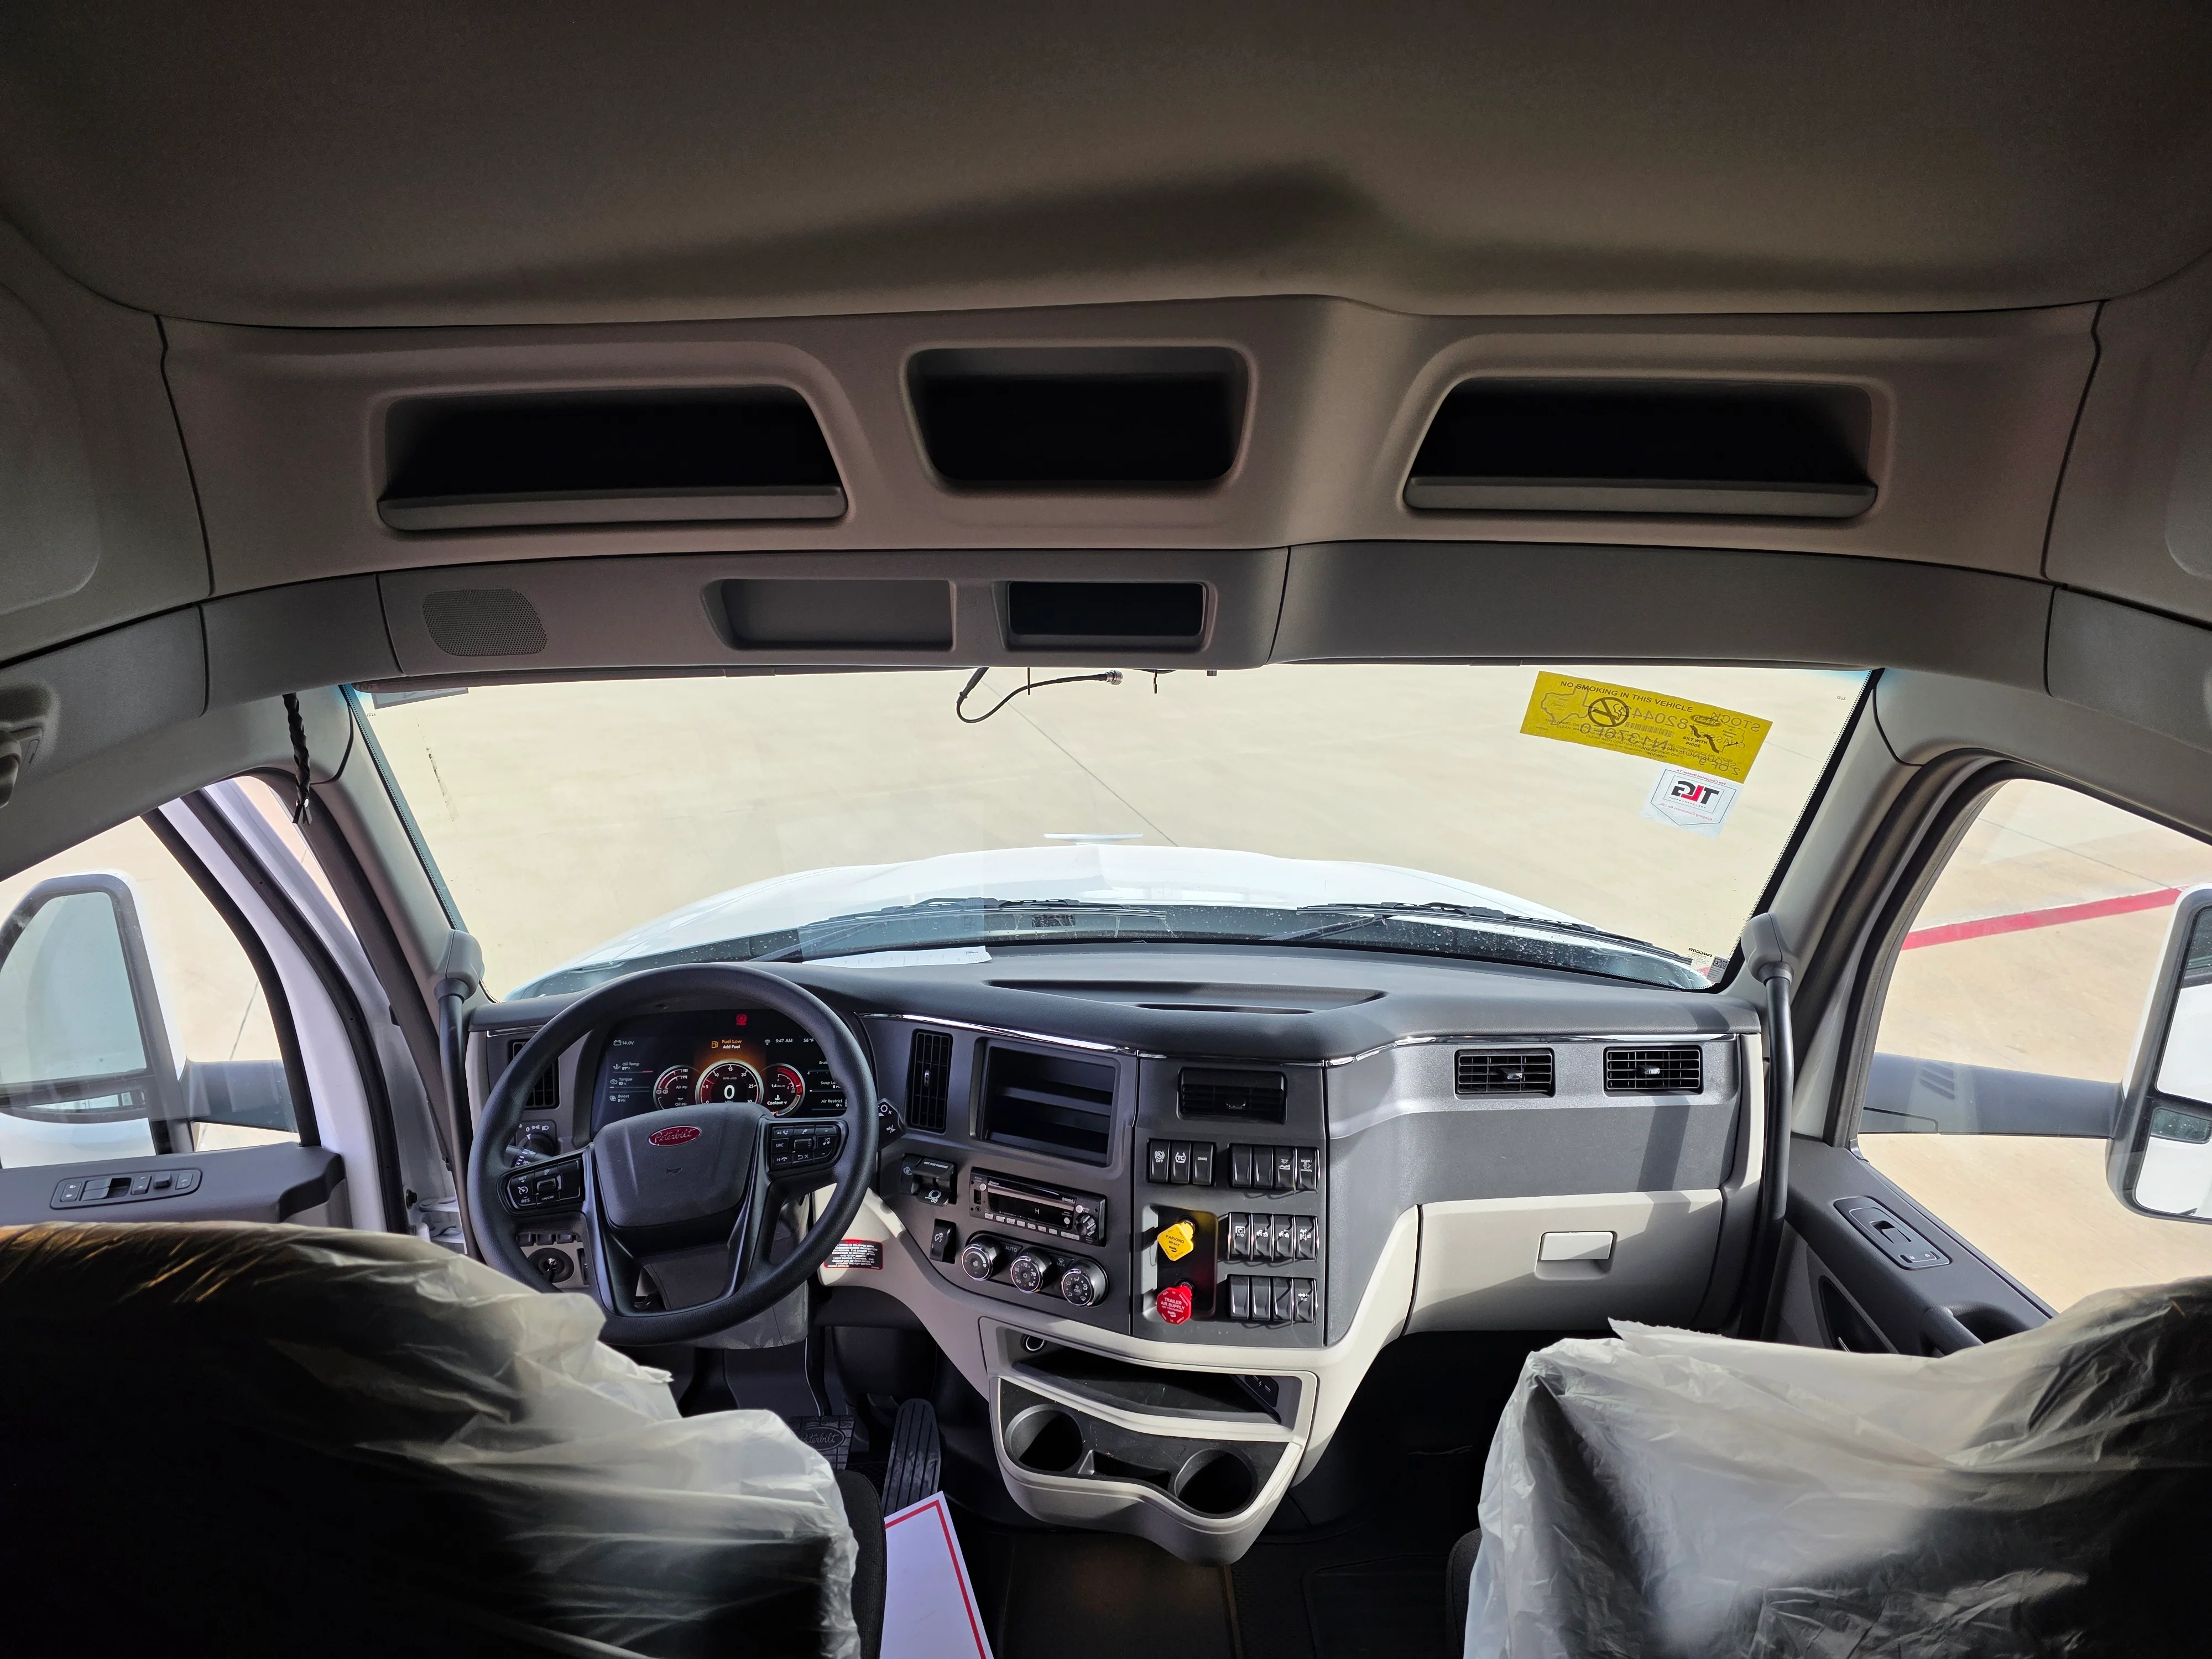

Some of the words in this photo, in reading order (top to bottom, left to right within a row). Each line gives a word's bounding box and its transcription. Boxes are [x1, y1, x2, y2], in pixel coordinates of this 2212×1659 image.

[1575, 684, 1618, 696] SMOKING
[1632, 694, 1652, 703] THIS
[1655, 698, 1693, 712] VEHICLE
[724, 1085, 735, 1099] 0
[654, 1129, 696, 1144] Peterbilt
[1166, 1235, 1185, 1244] PARKING
[1165, 1297, 1182, 1305] TRAILER
